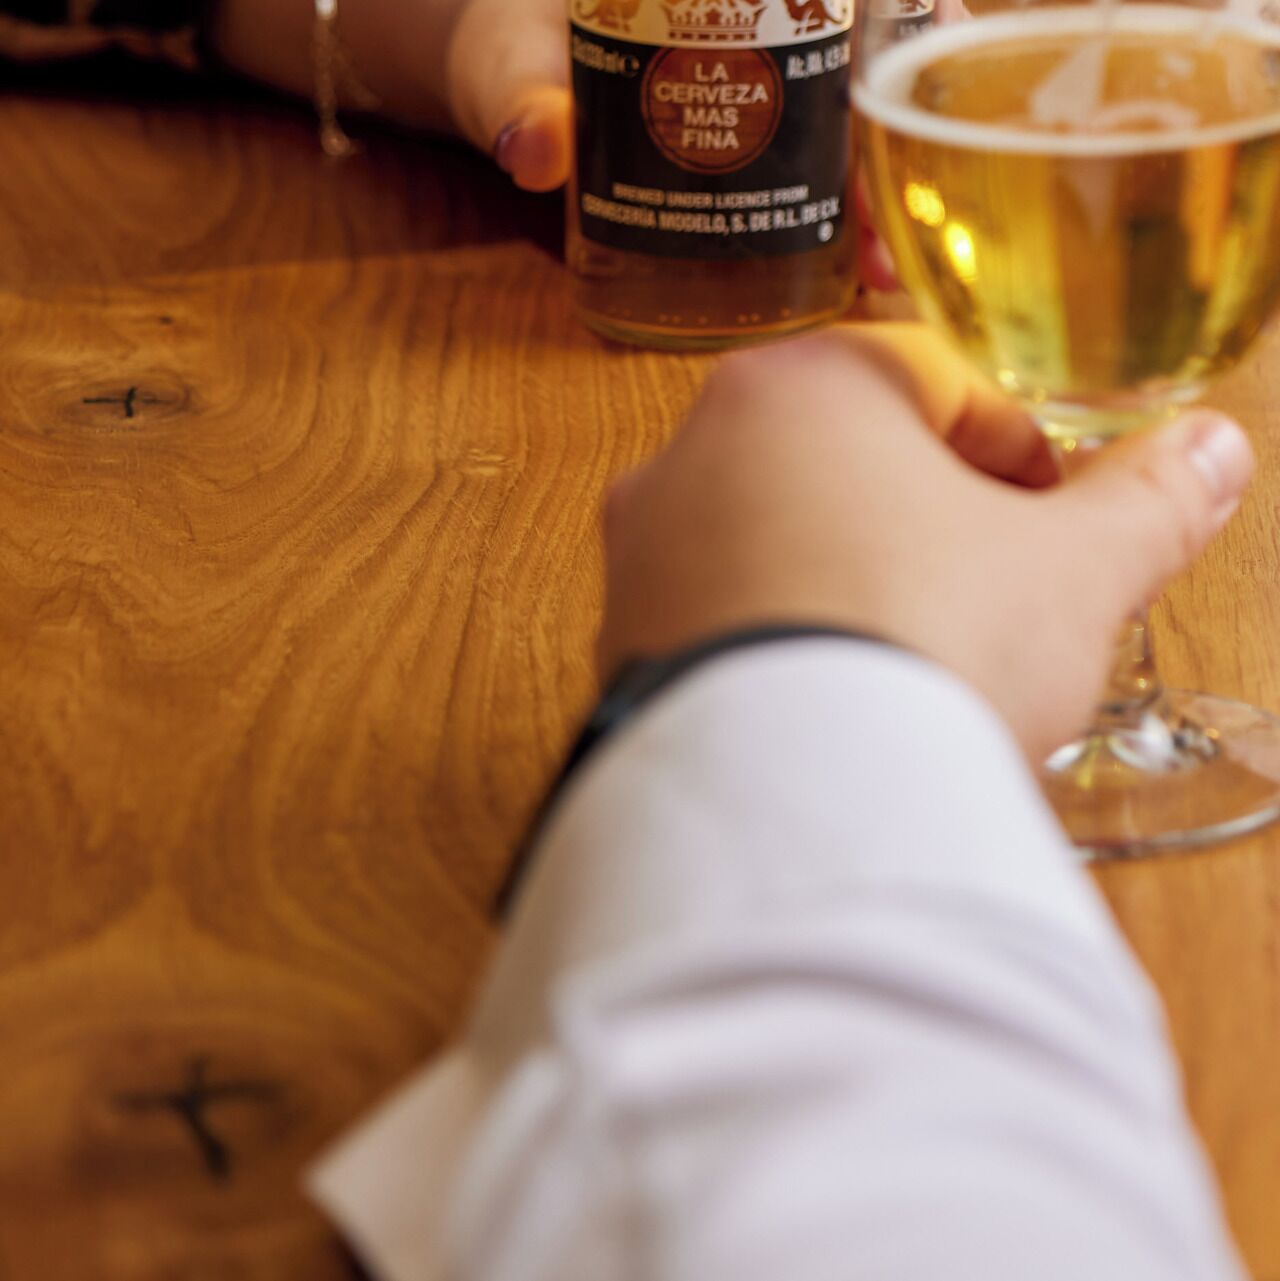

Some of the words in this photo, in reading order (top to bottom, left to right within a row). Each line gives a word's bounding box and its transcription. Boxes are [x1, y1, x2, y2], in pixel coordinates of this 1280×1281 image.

[694, 62, 730, 83] LA
[654, 82, 769, 105] CERVEZA
[682, 106, 740, 129] MAS
[681, 128, 740, 150] FINA
[666, 189, 714, 209] UNDER
[771, 184, 809, 206] FROM
